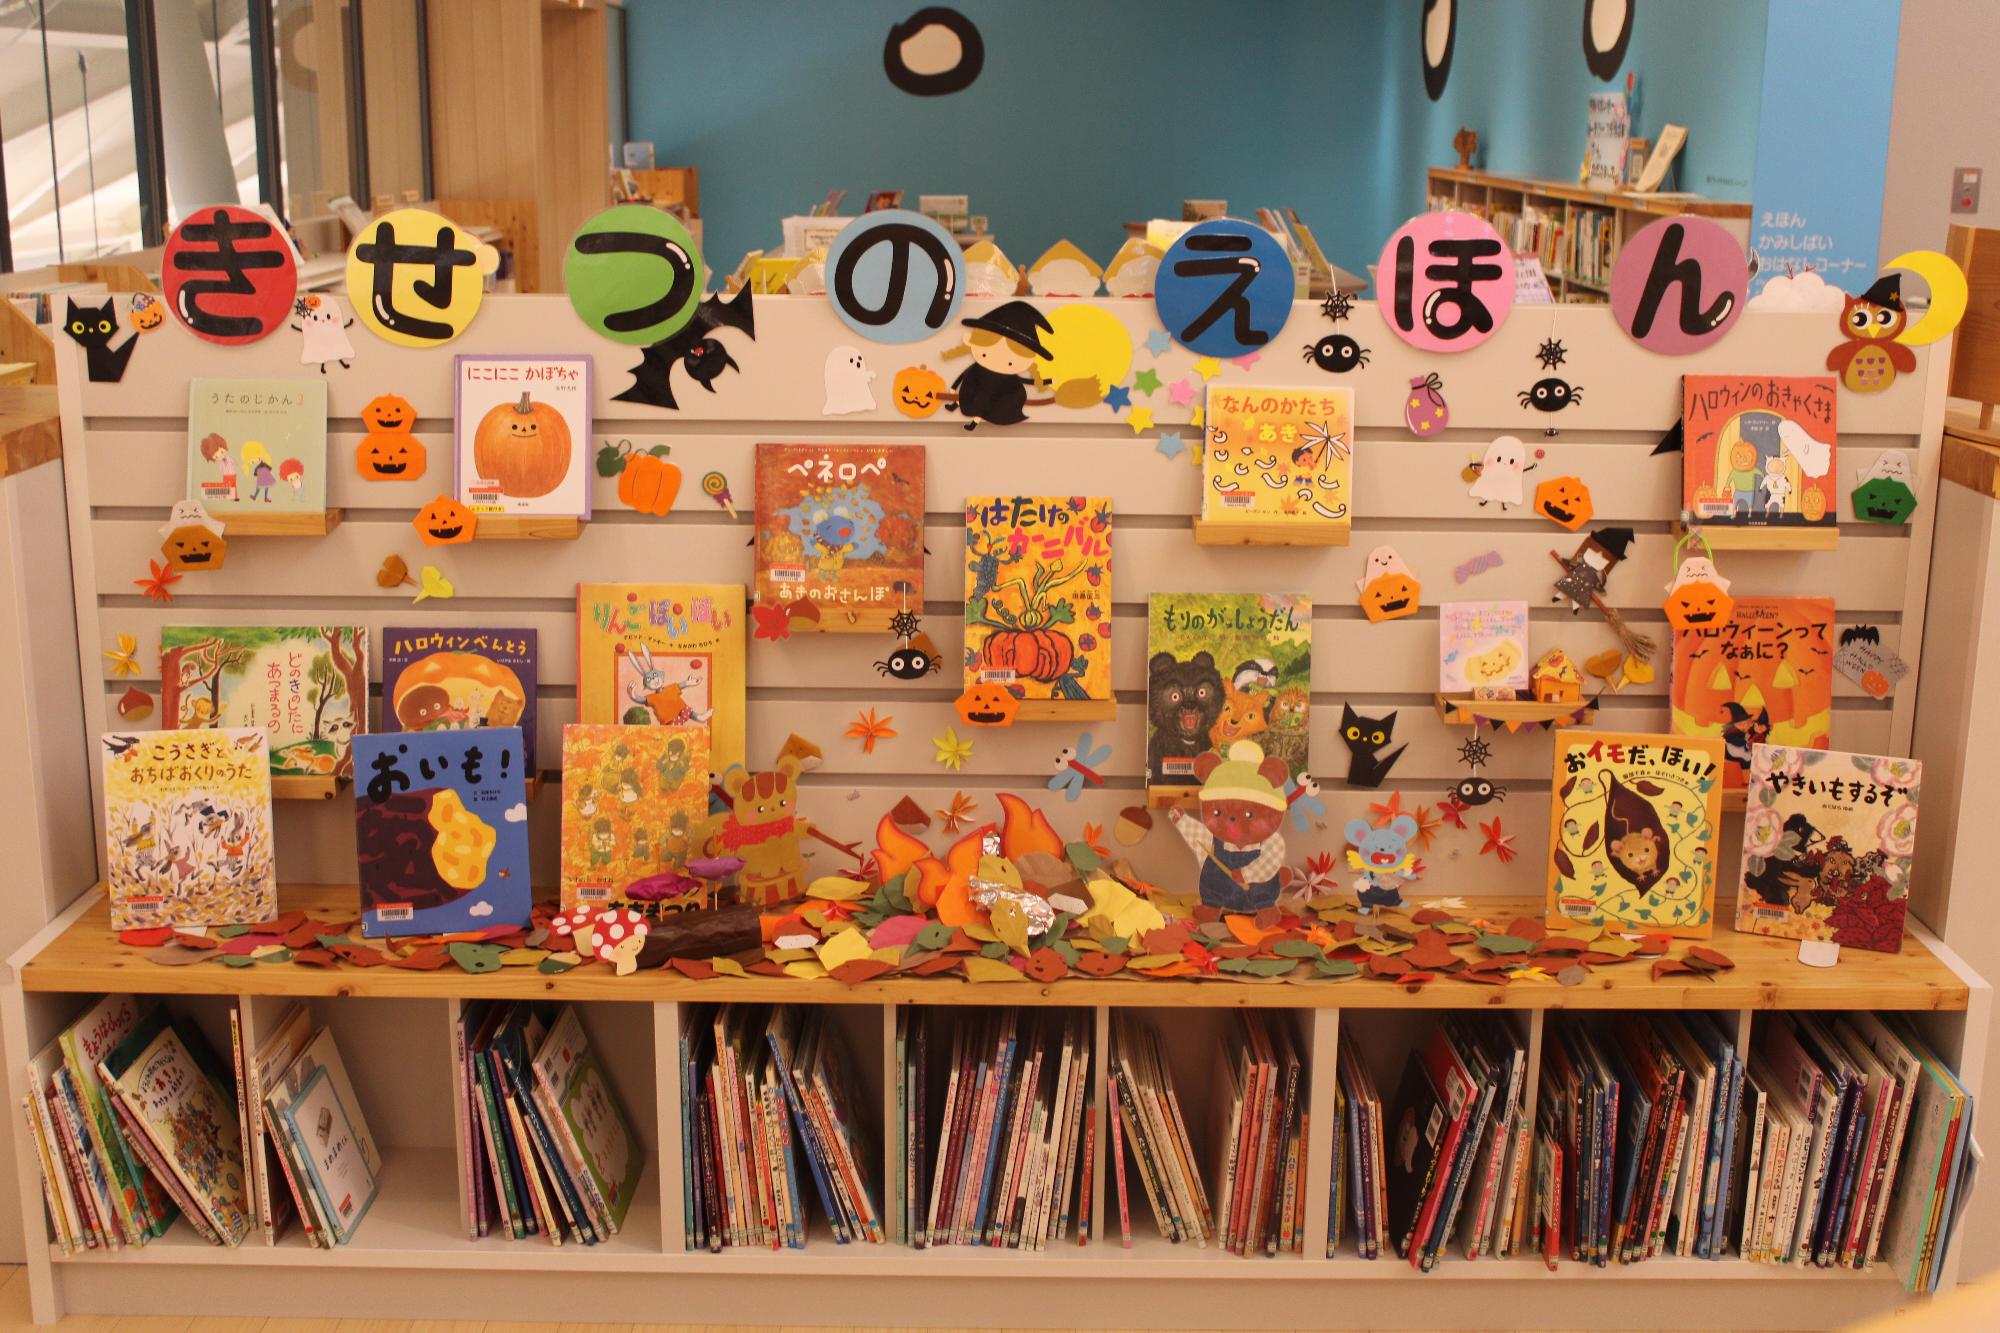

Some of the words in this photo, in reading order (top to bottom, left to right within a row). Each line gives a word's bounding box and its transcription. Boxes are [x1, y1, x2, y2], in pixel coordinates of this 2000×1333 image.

[1760, 211, 1806, 229] えほん
[1759, 234, 1833, 249] かみしばい
[468, 367, 519, 381] にこにこ
[525, 366, 579, 381] かぼちゃ
[211, 392, 293, 406] うたのじかん
[1223, 395, 1335, 416] なんのかたち
[1689, 380, 1832, 424] ハロウィンのおきゃくさま
[1258, 423, 1298, 443] あき
[787, 454, 887, 483] ペネロペ
[981, 496, 1070, 528] はたけの
[1008, 516, 1110, 560] カーニバル
[779, 583, 890, 604] あきのおさんぽ
[1163, 604, 1299, 632] もりのがっしょうだん
[394, 632, 527, 656] ハロウィンべんとう
[287, 651, 304, 735] どのきのしたに
[152, 742, 225, 761] こうさぎと
[130, 763, 253, 784] おちばおくりのうた
[1765, 771, 1908, 808] やきいもするぞ
